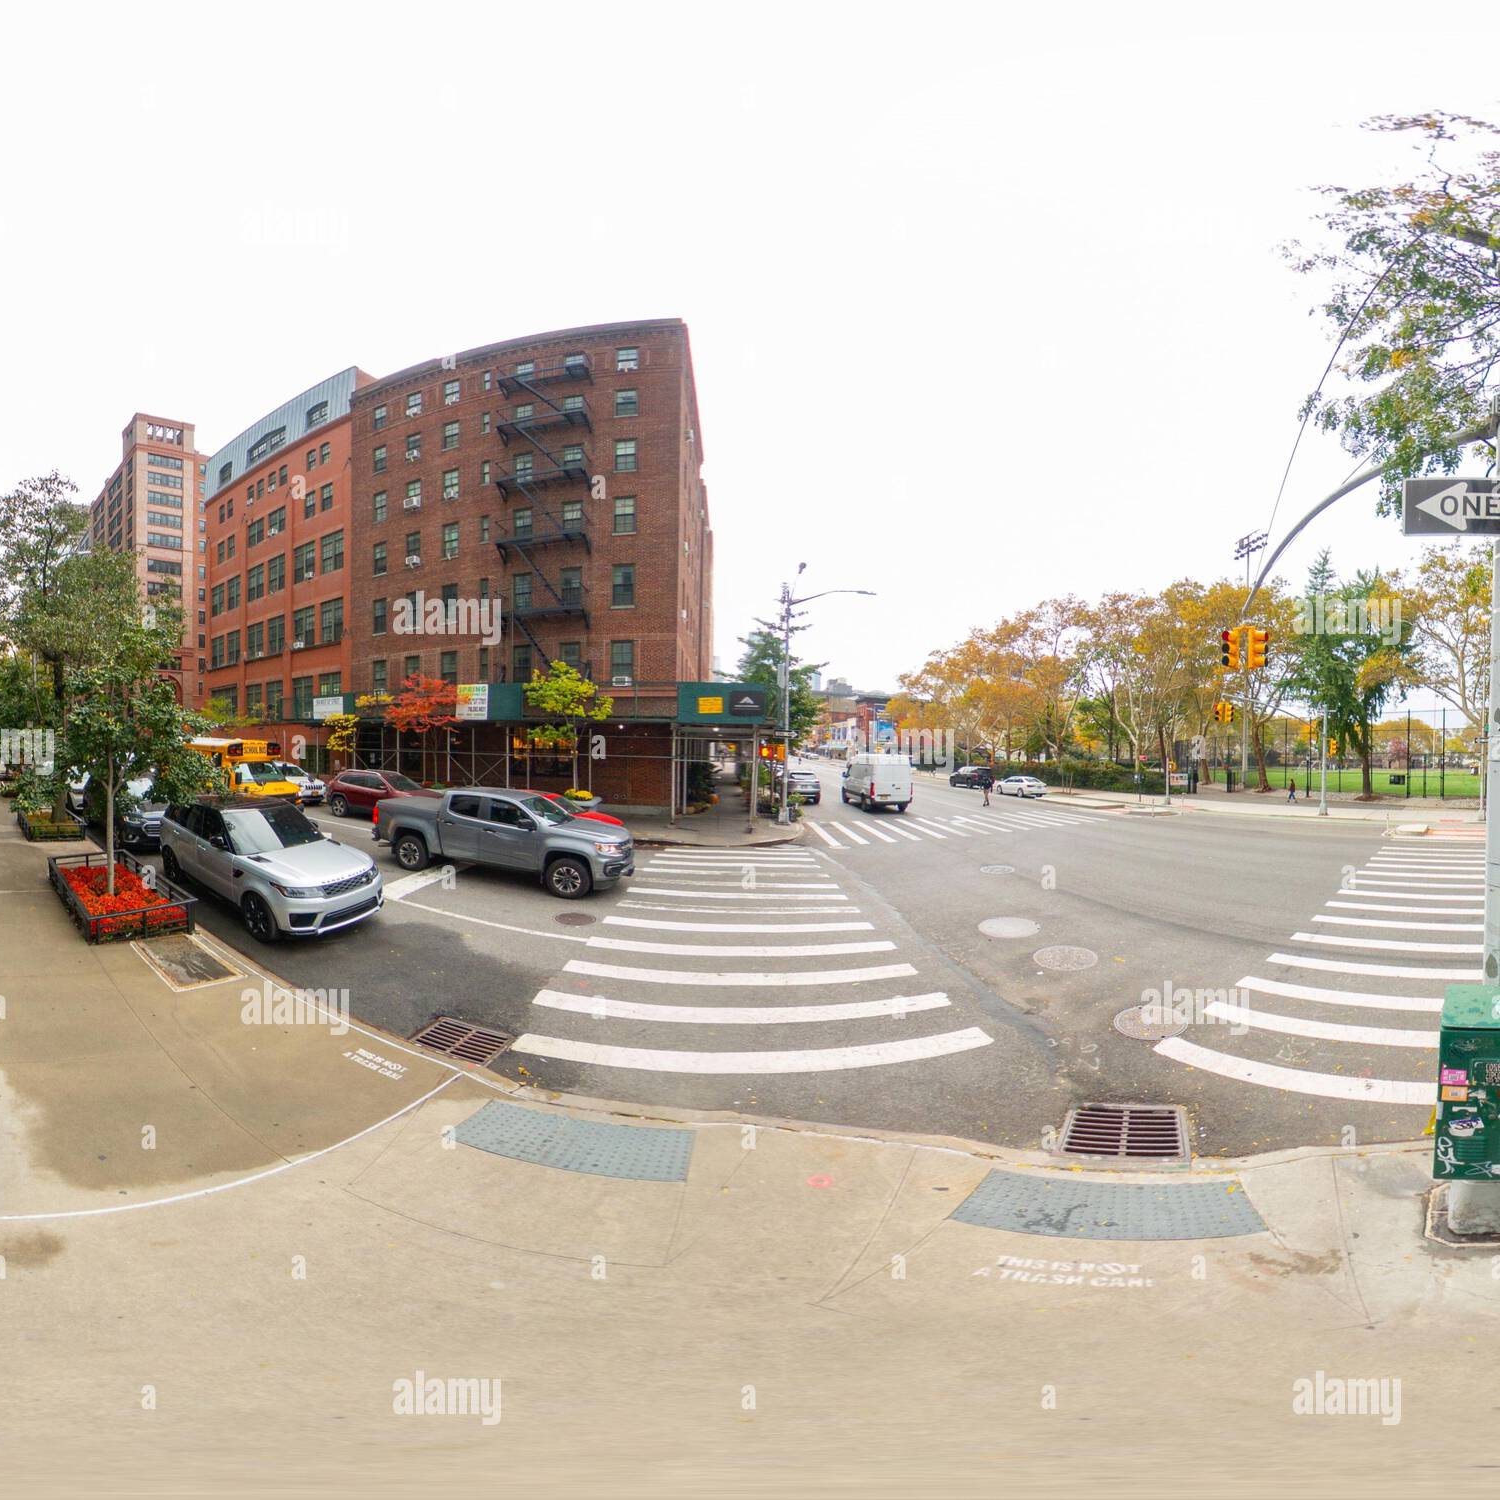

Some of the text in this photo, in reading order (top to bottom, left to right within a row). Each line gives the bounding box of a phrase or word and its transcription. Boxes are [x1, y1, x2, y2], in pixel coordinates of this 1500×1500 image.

[1440, 495, 1500, 517] ONE
[244, 746, 267, 754] SCHOOL BUS
[350, 1054, 381, 1071] TRASH
[355, 1048, 375, 1060] THIS
[373, 1056, 385, 1064] IS
[996, 1255, 1142, 1275] THIS IS NOT
[972, 1266, 992, 1277] A
[998, 1269, 1085, 1285] TRASH
